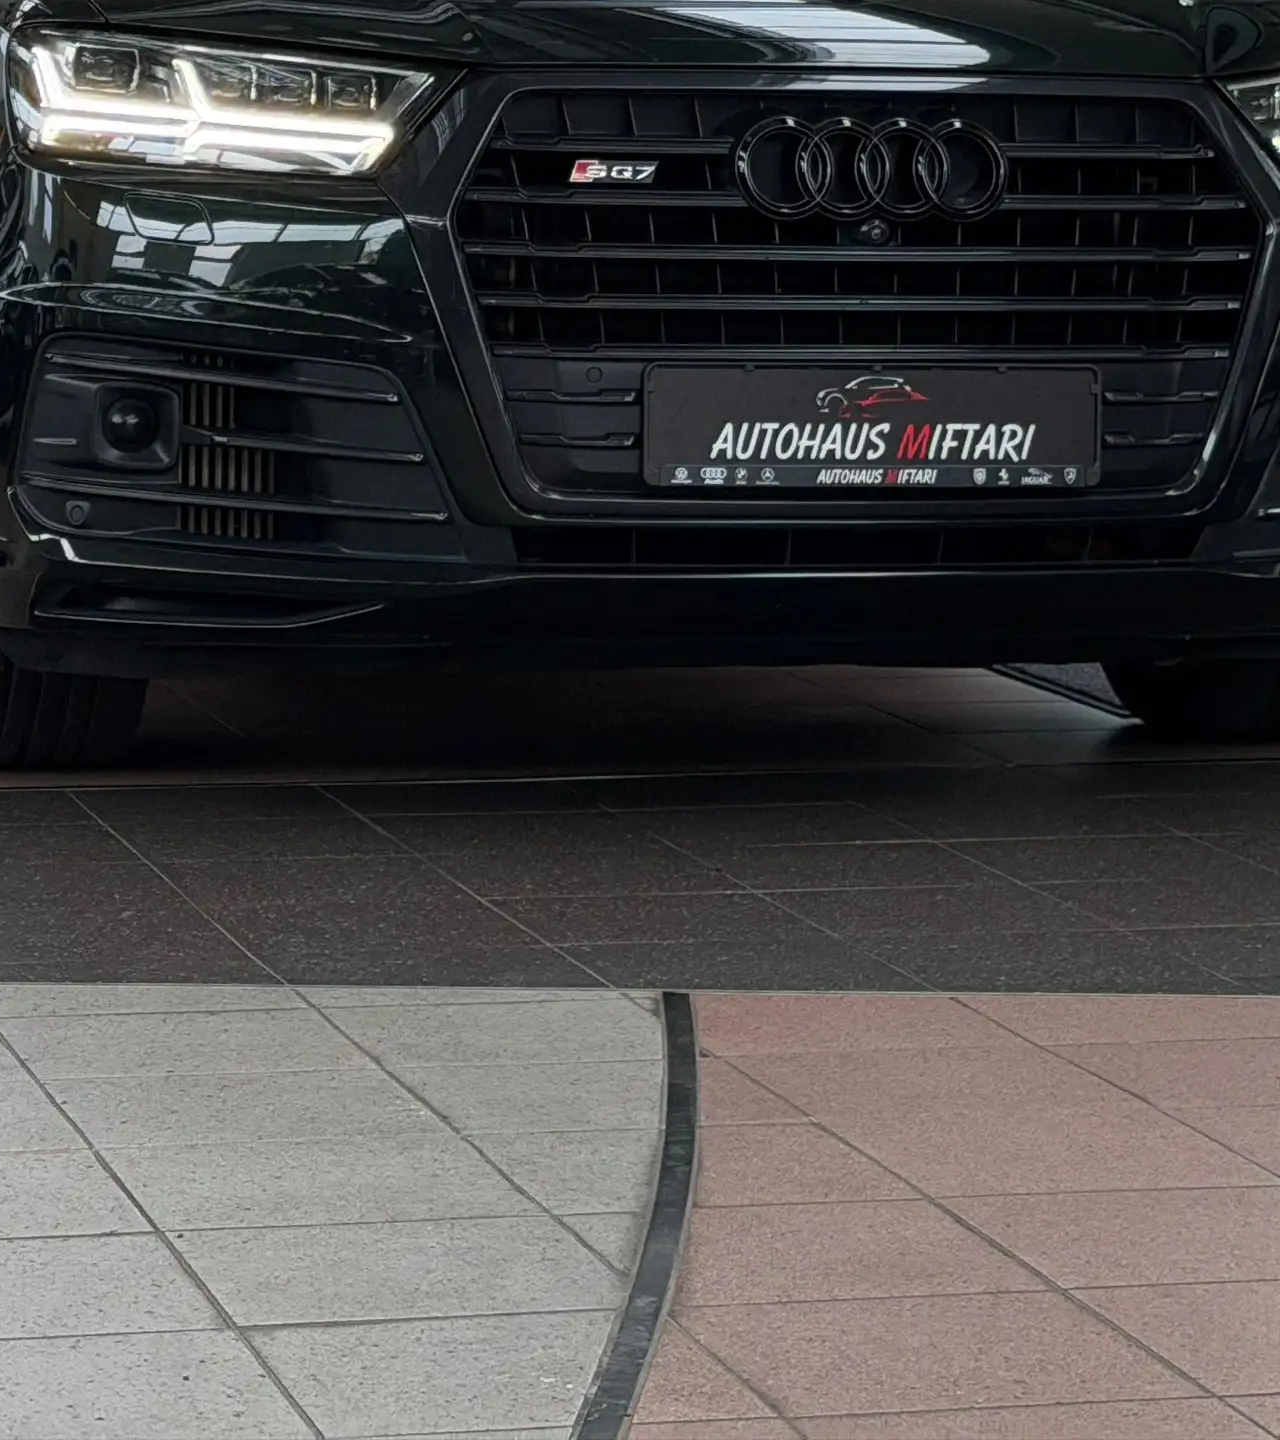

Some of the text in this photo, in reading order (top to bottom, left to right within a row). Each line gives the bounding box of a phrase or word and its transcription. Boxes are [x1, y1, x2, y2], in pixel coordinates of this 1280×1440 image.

[582, 163, 656, 181] SQ7
[709, 422, 1037, 463] AUTOHAUS MIFTARI
[816, 468, 939, 485] AUTOHAUS MIFTARI
